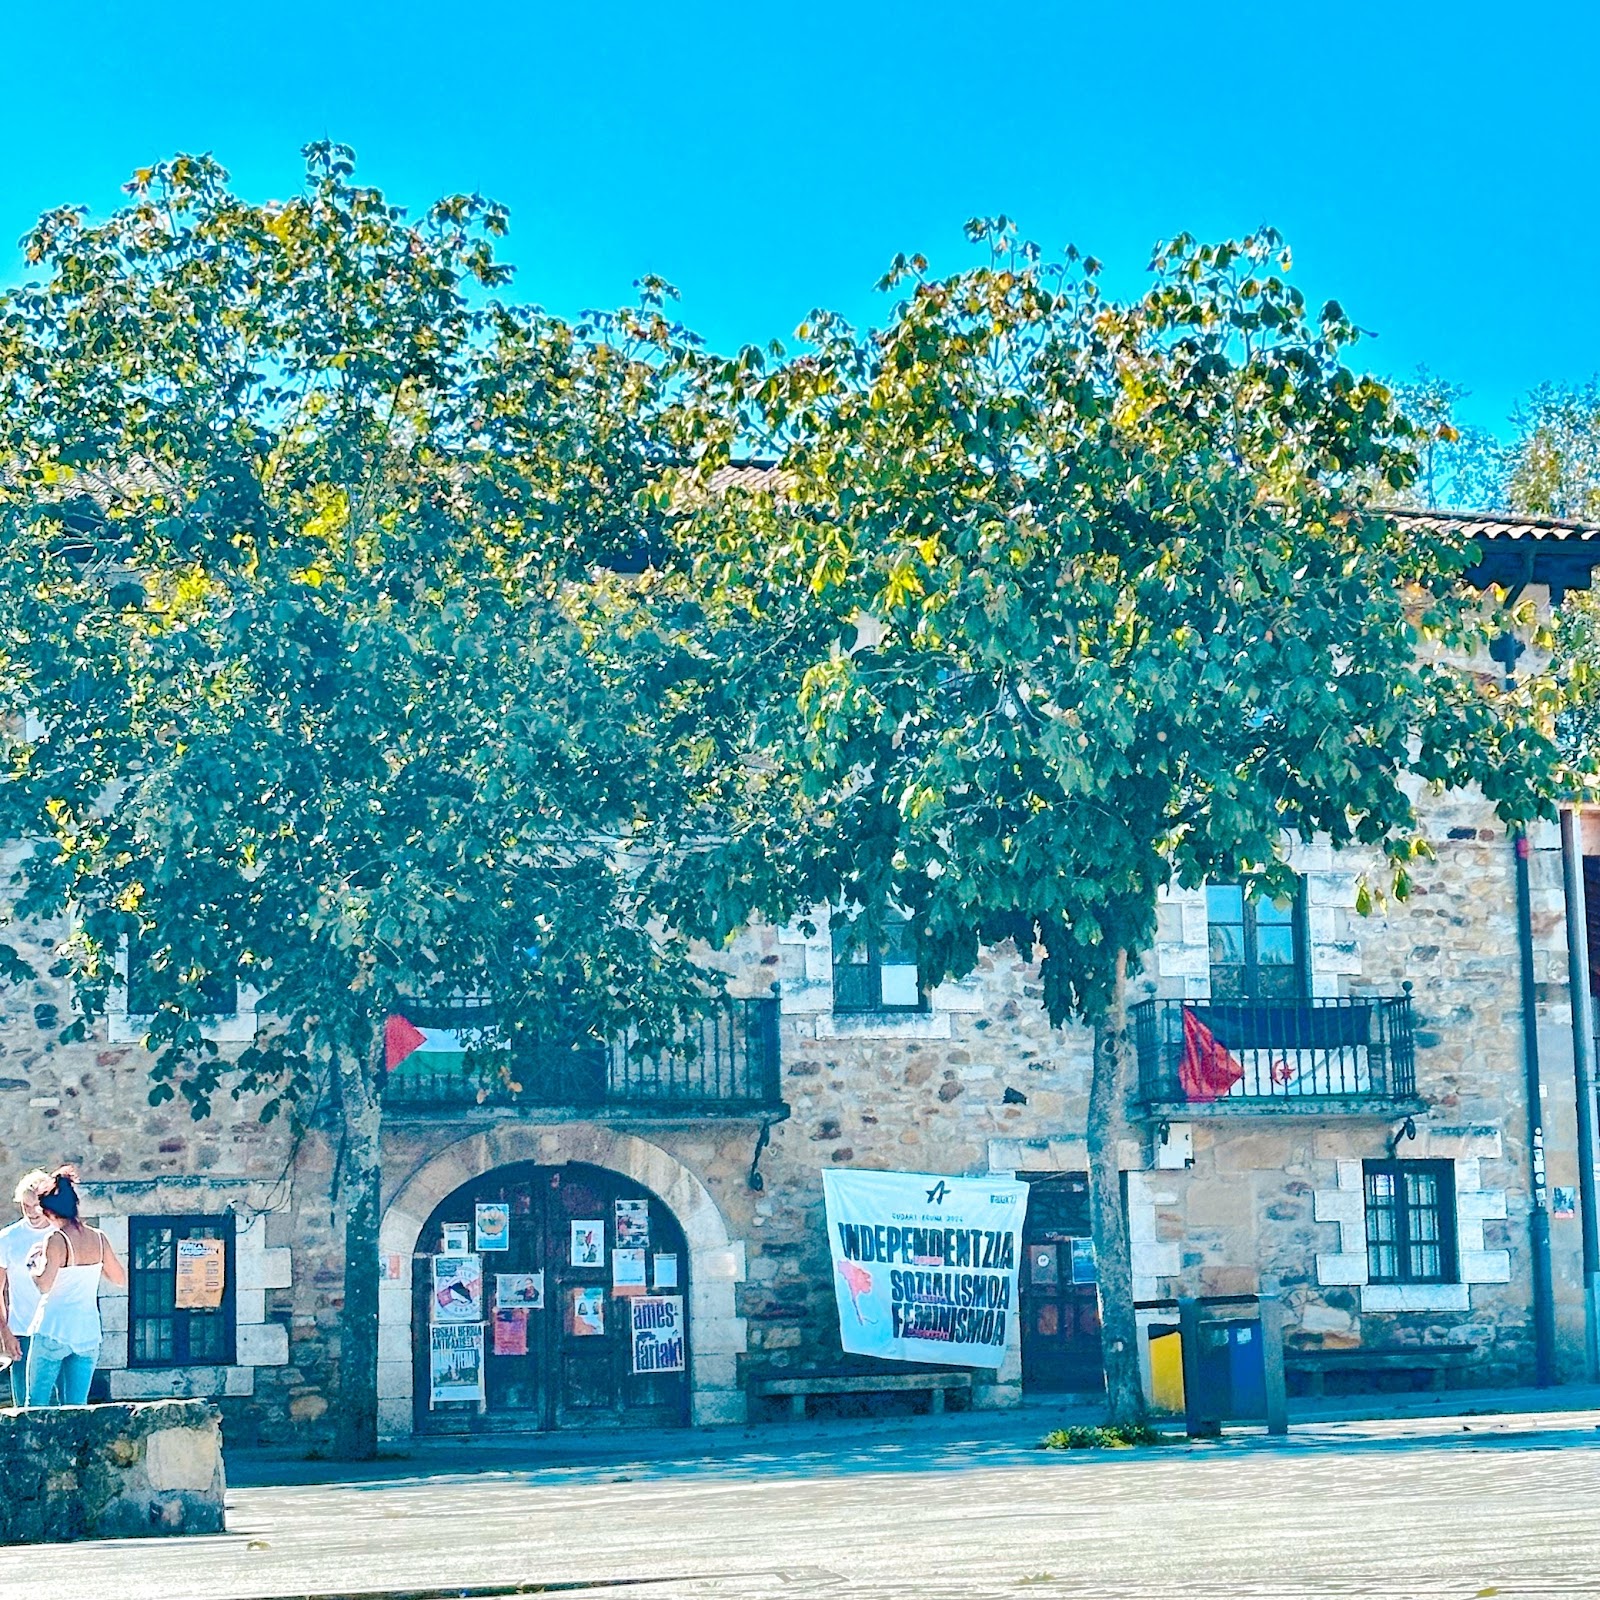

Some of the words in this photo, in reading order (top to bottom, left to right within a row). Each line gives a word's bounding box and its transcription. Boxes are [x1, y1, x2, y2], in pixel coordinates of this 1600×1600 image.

[837, 1222, 1014, 1269] INDEPENDENTZIA
[890, 1269, 1010, 1310] SOZIALISMOA
[891, 1303, 1006, 1347] FEMINISMOA
